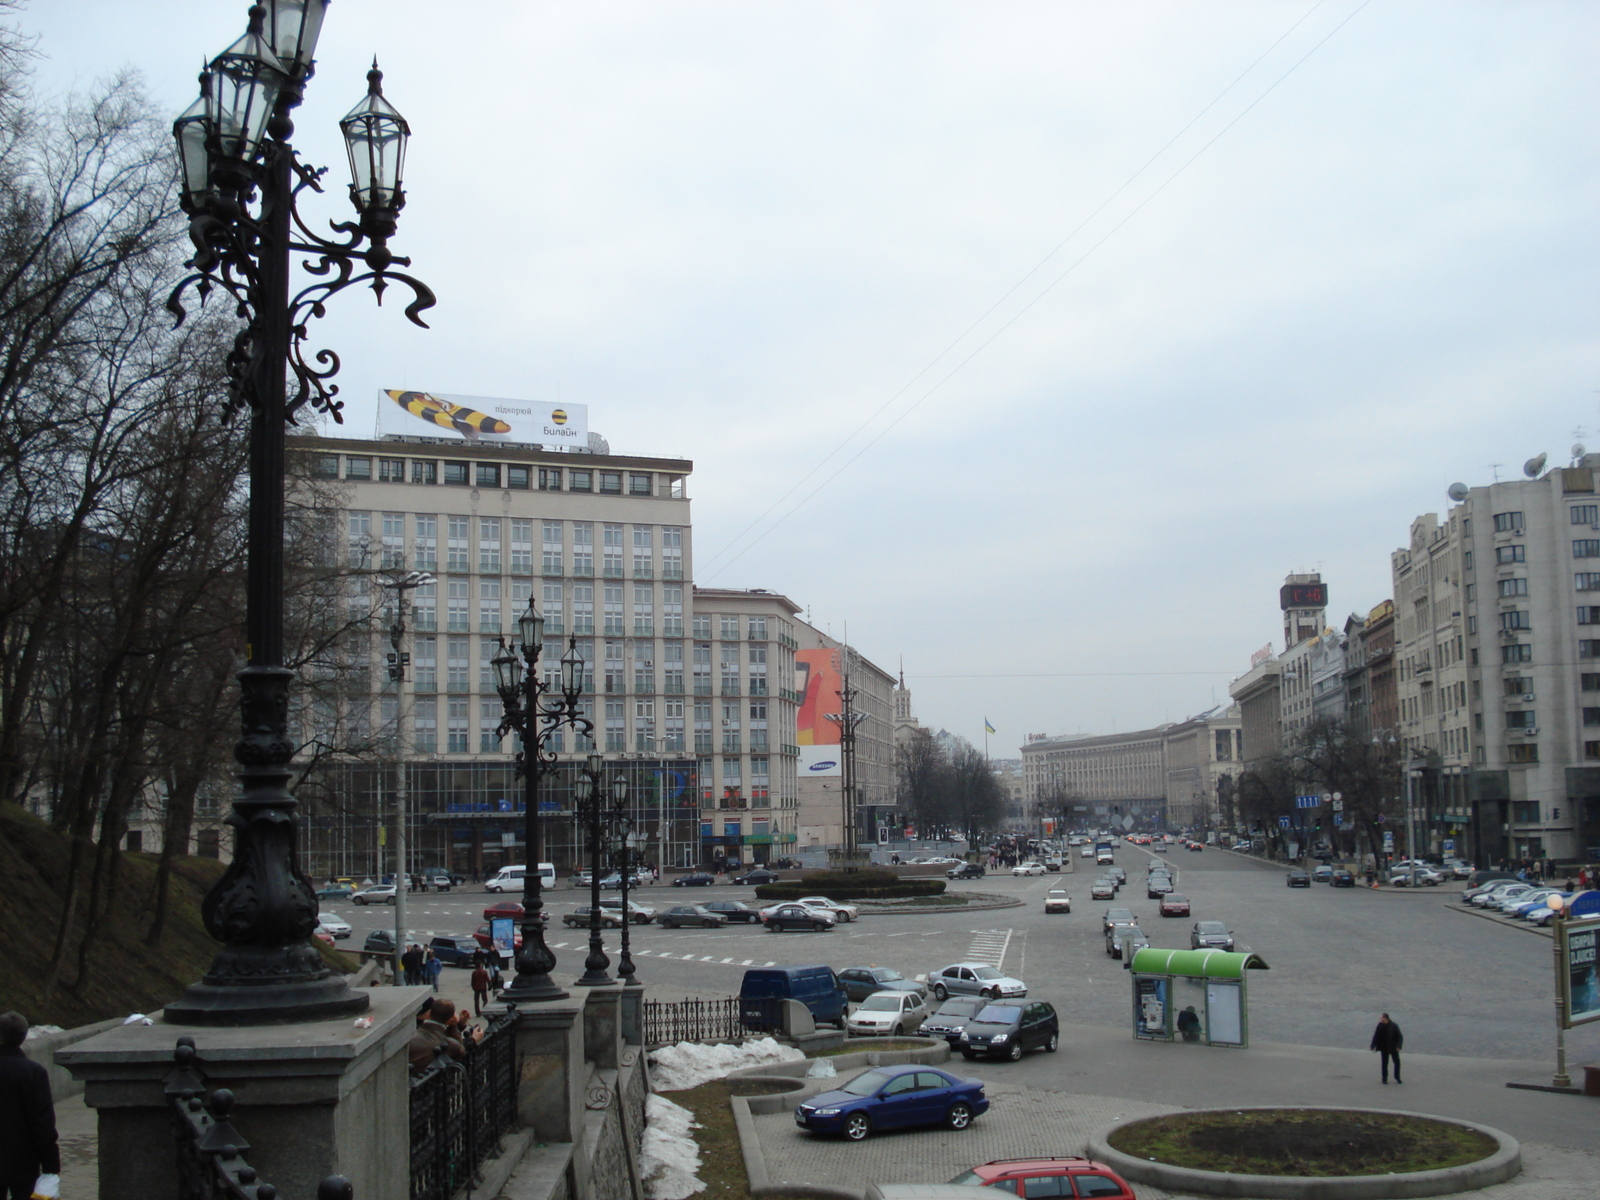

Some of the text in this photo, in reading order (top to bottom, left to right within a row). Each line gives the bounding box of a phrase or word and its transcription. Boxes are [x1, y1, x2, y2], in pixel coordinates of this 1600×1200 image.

[494, 405, 532, 416] підкорюй
[543, 426, 577, 437] Билайн
[811, 762, 835, 770] SAMSUNG
